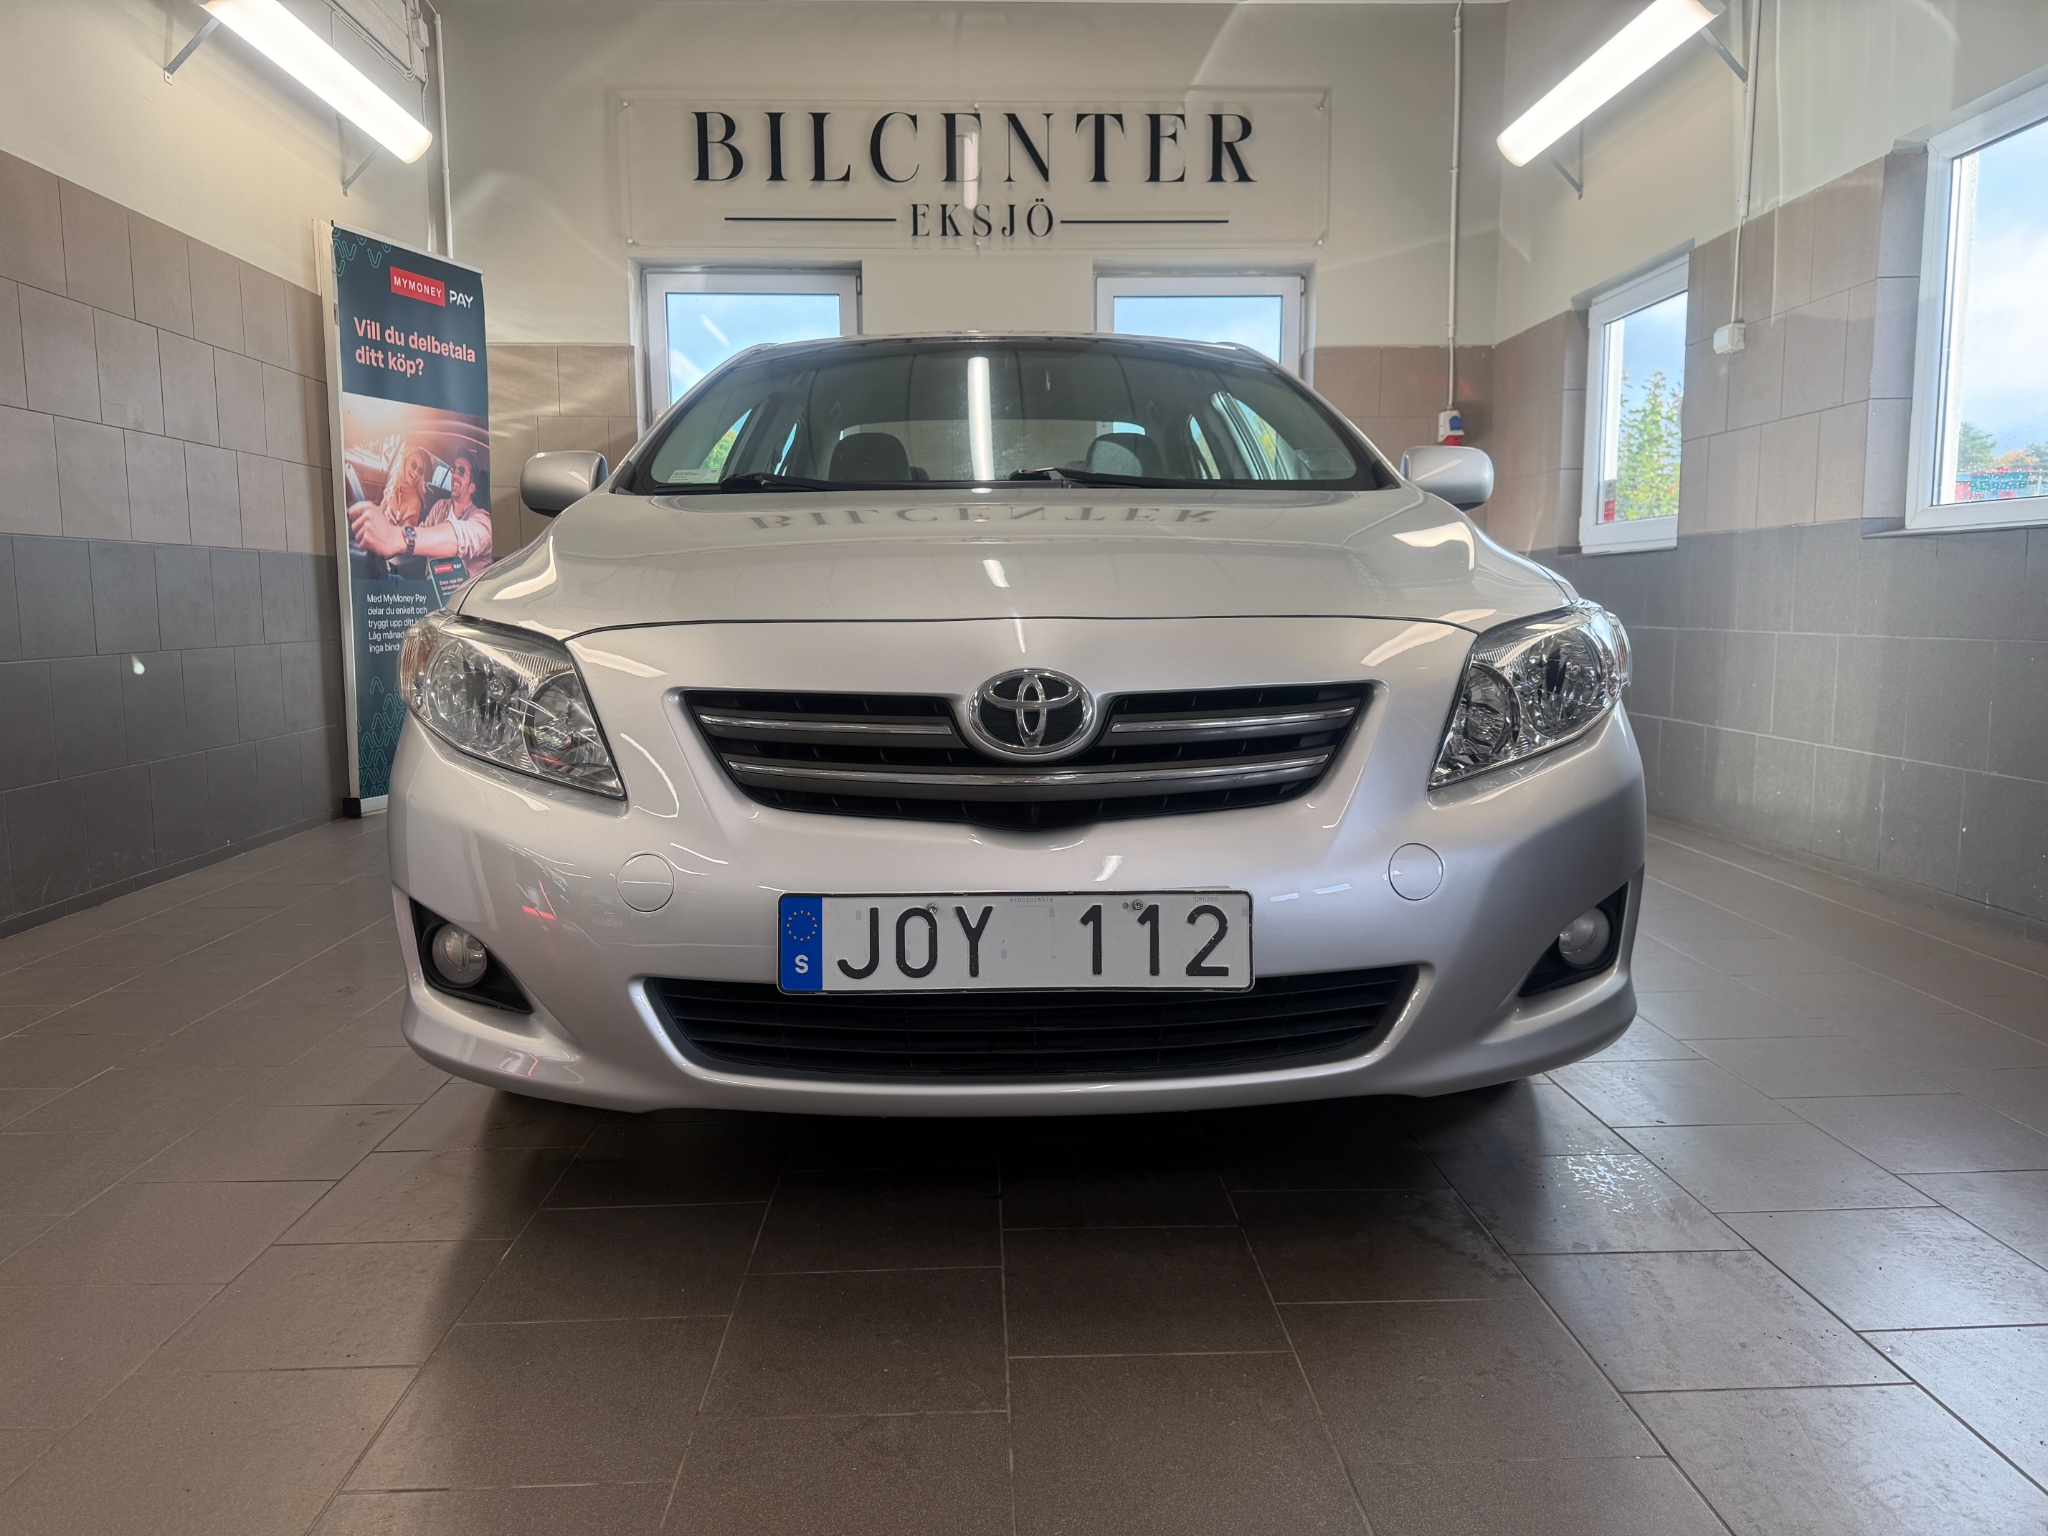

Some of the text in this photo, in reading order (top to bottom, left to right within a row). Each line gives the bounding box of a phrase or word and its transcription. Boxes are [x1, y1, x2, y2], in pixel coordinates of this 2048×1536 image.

[691, 111, 1258, 184] BILCENTER
[911, 197, 1054, 238] EKSJÖ
[393, 275, 474, 309] MYMONEY PAY
[354, 316, 476, 363] Vill du delbetala
[355, 345, 424, 377] ditt köp?
[366, 593, 427, 605] Med MyMoney Pay
[367, 605, 428, 615] delar du enkelt och
[368, 618, 389, 630] tryggt
[390, 619, 403, 629] upp
[403, 617, 414, 627] ditt
[368, 630, 382, 642] Låg
[369, 643, 384, 654] inga
[837, 903, 1230, 979] JOY 112
[794, 953, 809, 974] S
